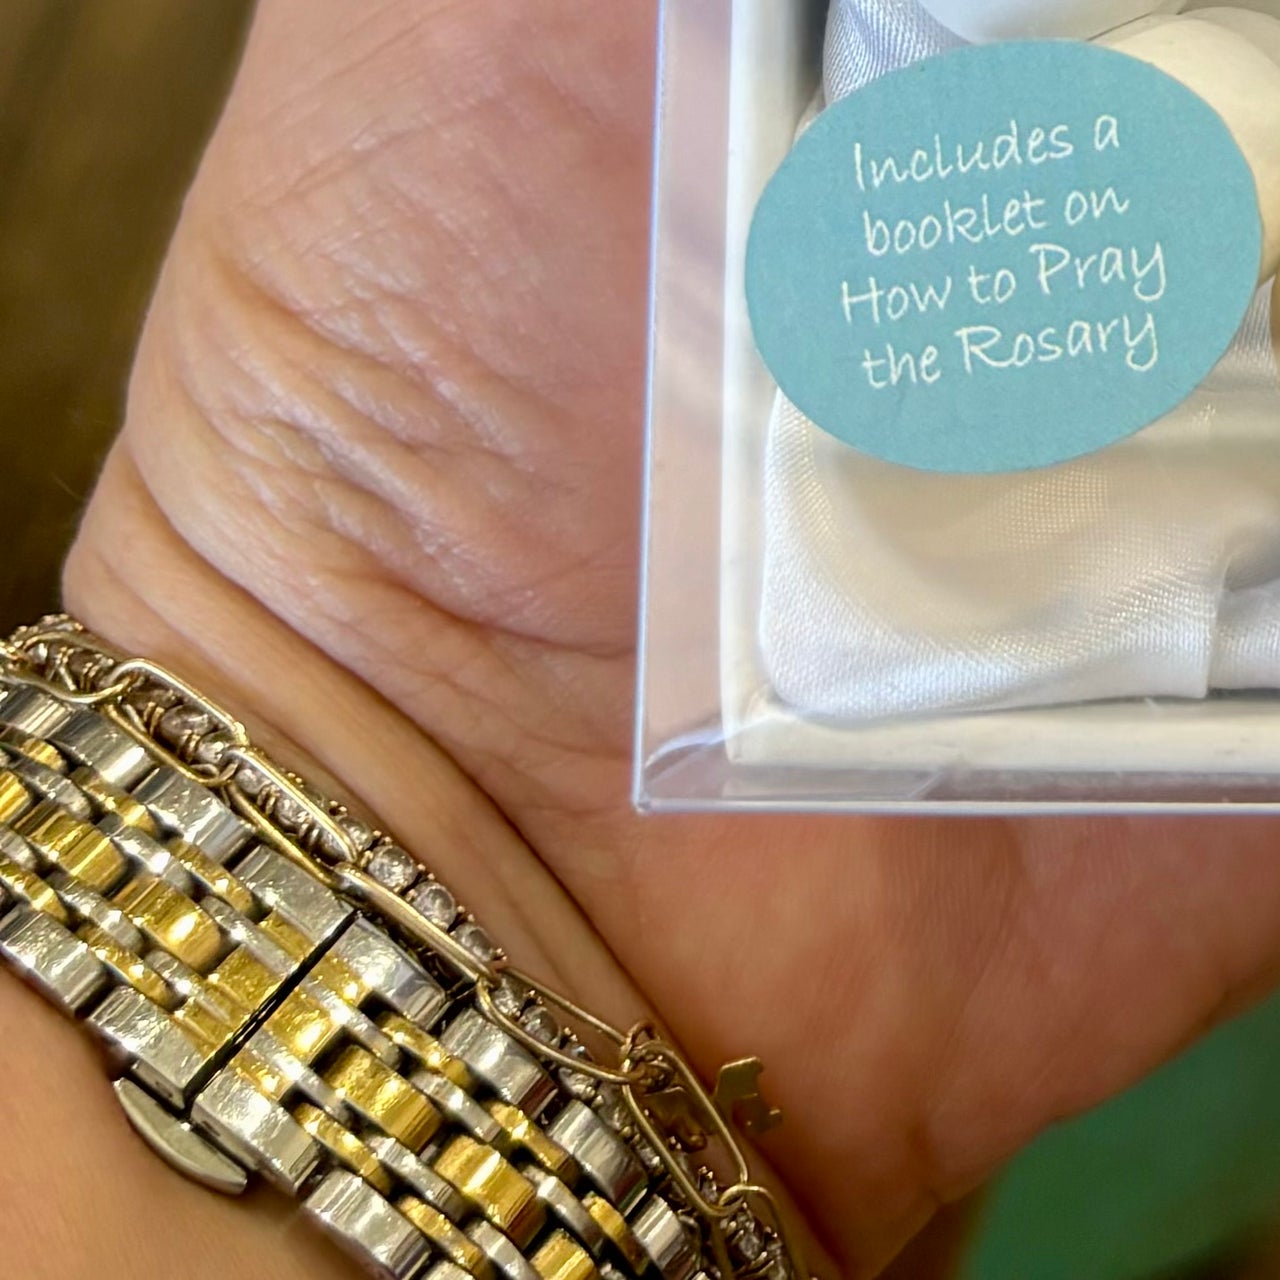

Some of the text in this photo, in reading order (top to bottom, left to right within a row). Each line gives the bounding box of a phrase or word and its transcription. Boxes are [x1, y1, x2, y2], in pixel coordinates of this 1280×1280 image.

[853, 113, 1121, 190] Includes a
[862, 187, 1129, 257] booklet on
[840, 240, 1167, 324] How to Pray
[860, 311, 1160, 389] the Rosary
